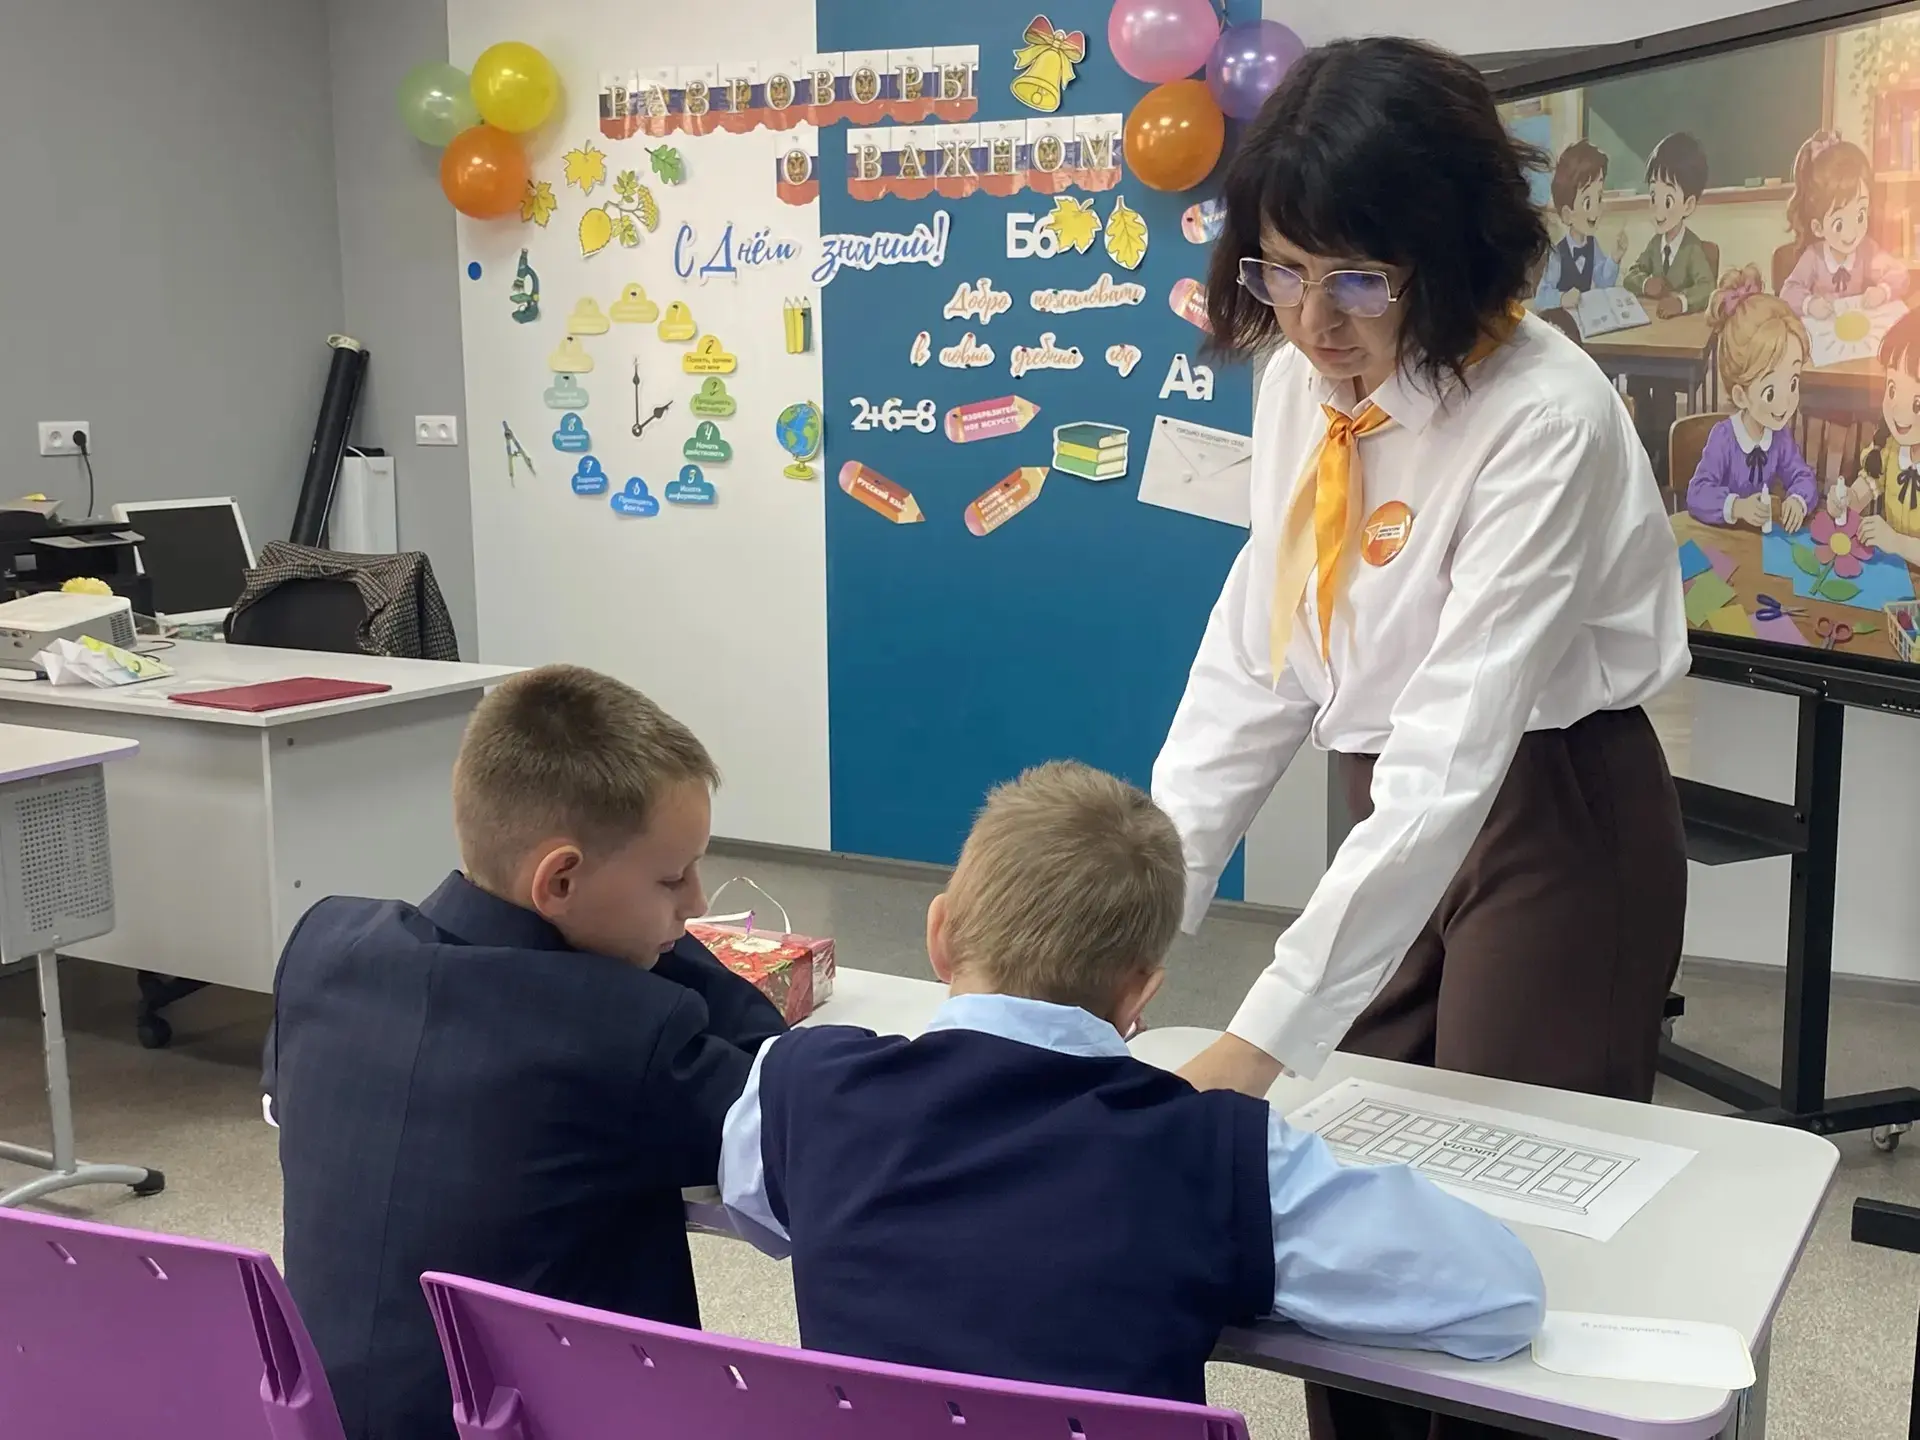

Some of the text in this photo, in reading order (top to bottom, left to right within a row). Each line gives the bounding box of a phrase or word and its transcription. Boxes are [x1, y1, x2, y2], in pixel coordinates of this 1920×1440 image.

[605, 62, 977, 120] РАЗГОВОРЫ
[781, 130, 1117, 186] О ВАЖНОМ
[674, 216, 945, 282] С Днём знаний!
[948, 280, 1008, 323] Добро
[1034, 274, 1142, 309] пожаловать
[1159, 353, 1214, 400] Аа
[850, 397, 936, 433] 2+6=8
[1443, 1141, 1498, 1157] ШКОЛА
